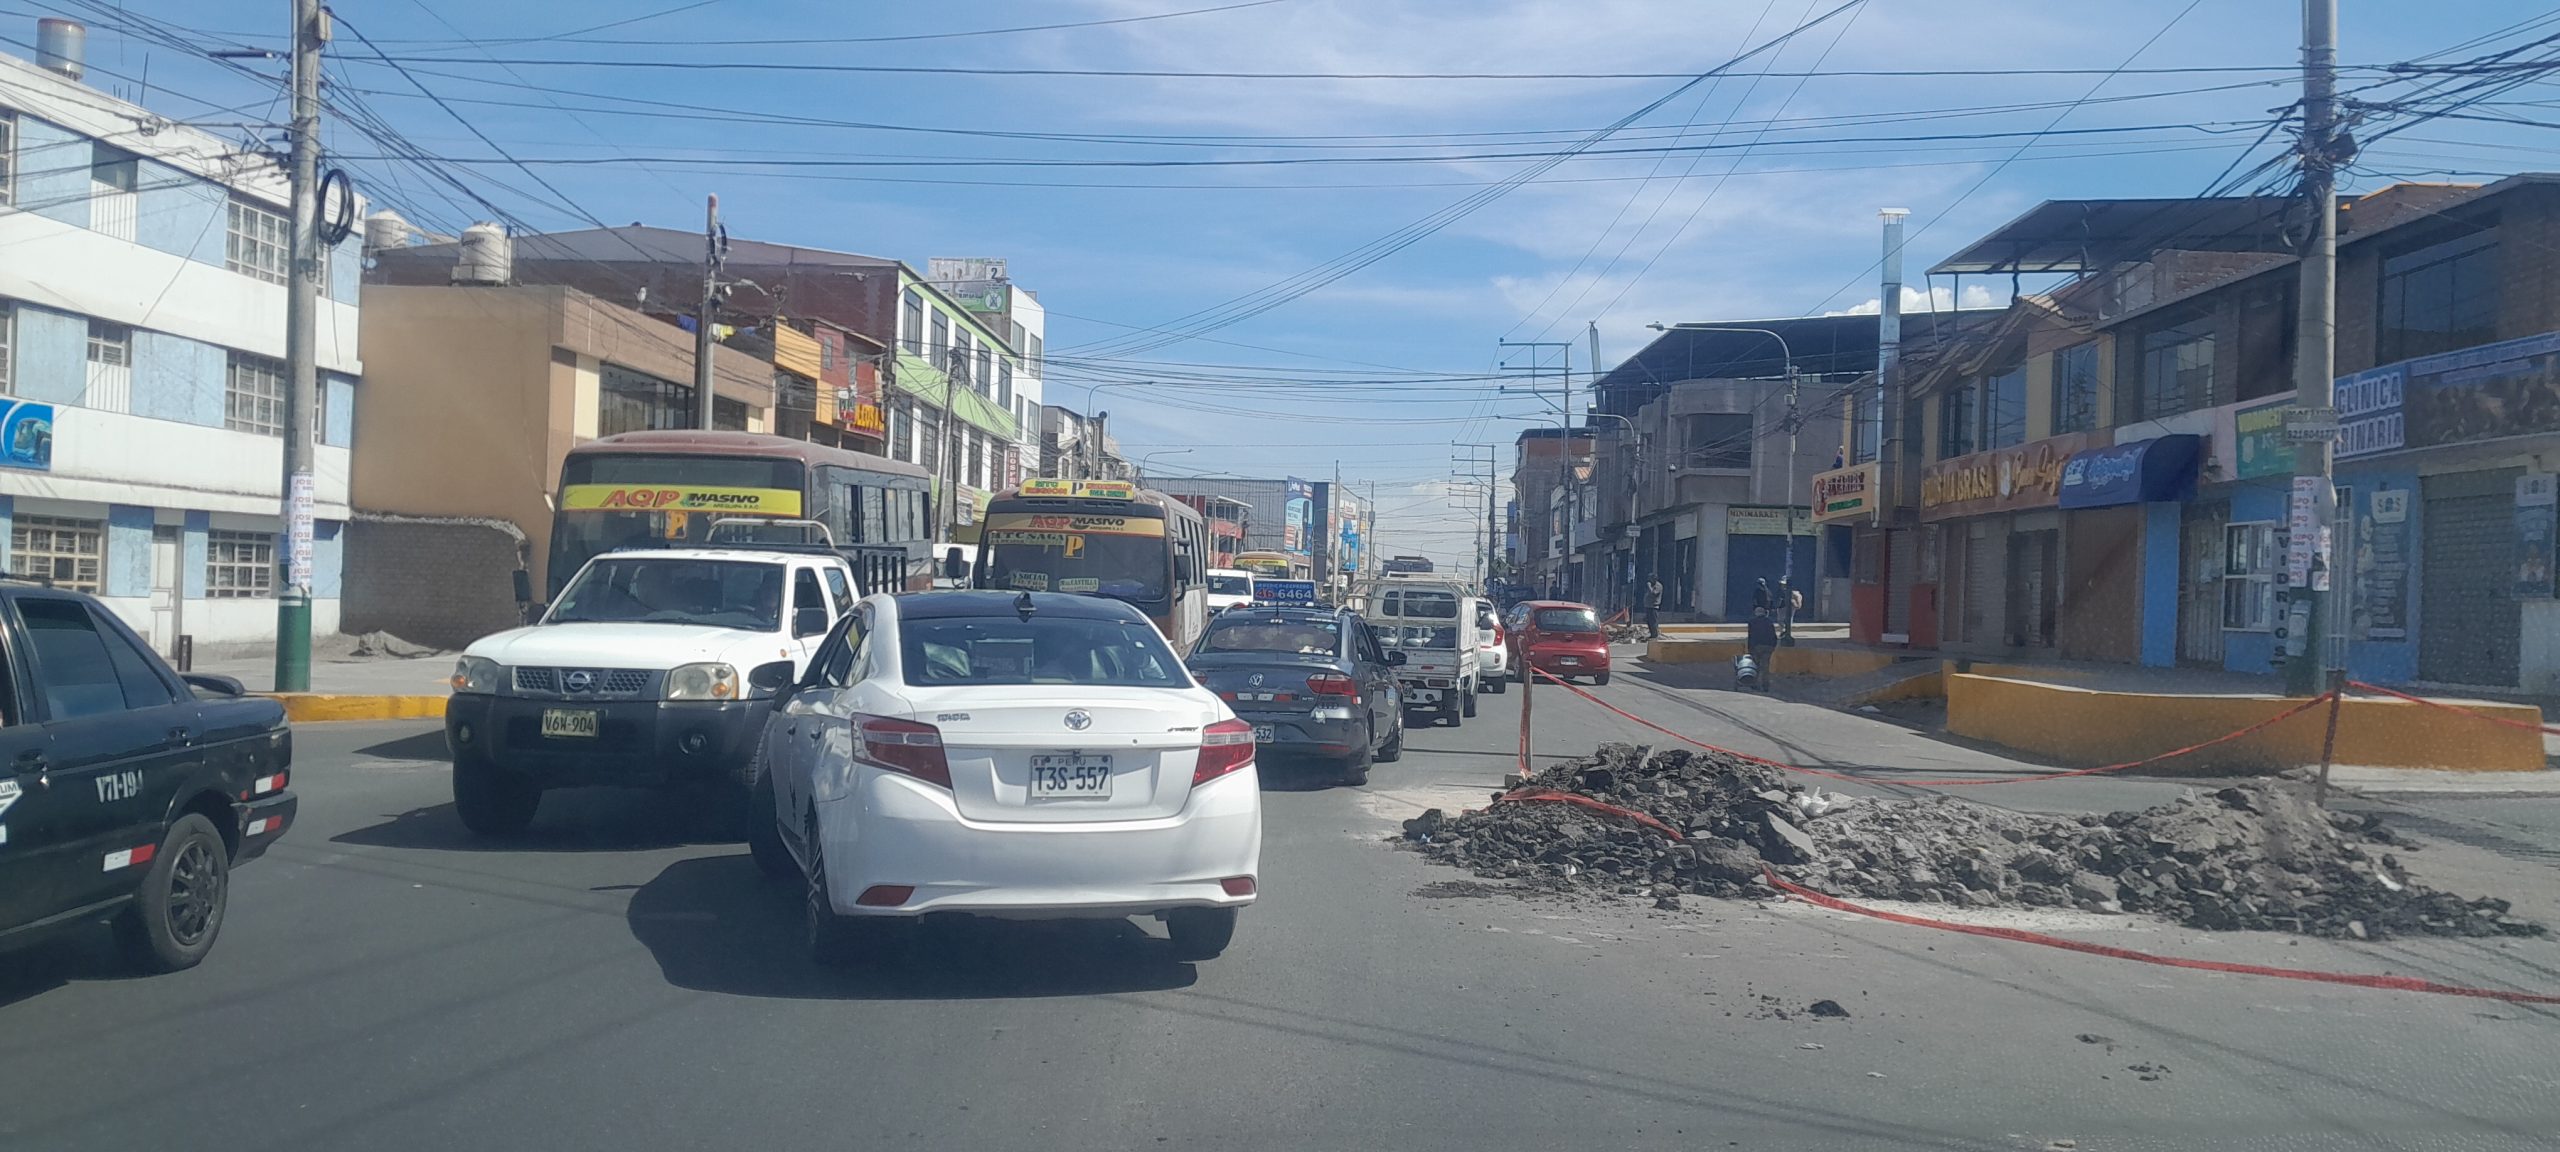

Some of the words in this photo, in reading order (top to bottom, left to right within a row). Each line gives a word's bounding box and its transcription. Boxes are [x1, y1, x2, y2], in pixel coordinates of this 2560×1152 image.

[1071, 482, 1084, 495] P
[1957, 465, 1995, 501] BRASA
[600, 488, 681, 508] AQP
[688, 492, 760, 504] MASIVO
[1028, 515, 1072, 529] AQP
[1075, 517, 1125, 526] MASIVO
[1729, 510, 1780, 519] MINIMARKET
[1065, 535, 1083, 557] P
[1255, 588, 1275, 599] 46
[1278, 589, 1312, 599] 6464
[2275, 536, 2290, 657] VIDRIOS
[1035, 765, 1109, 791] T3S-557
